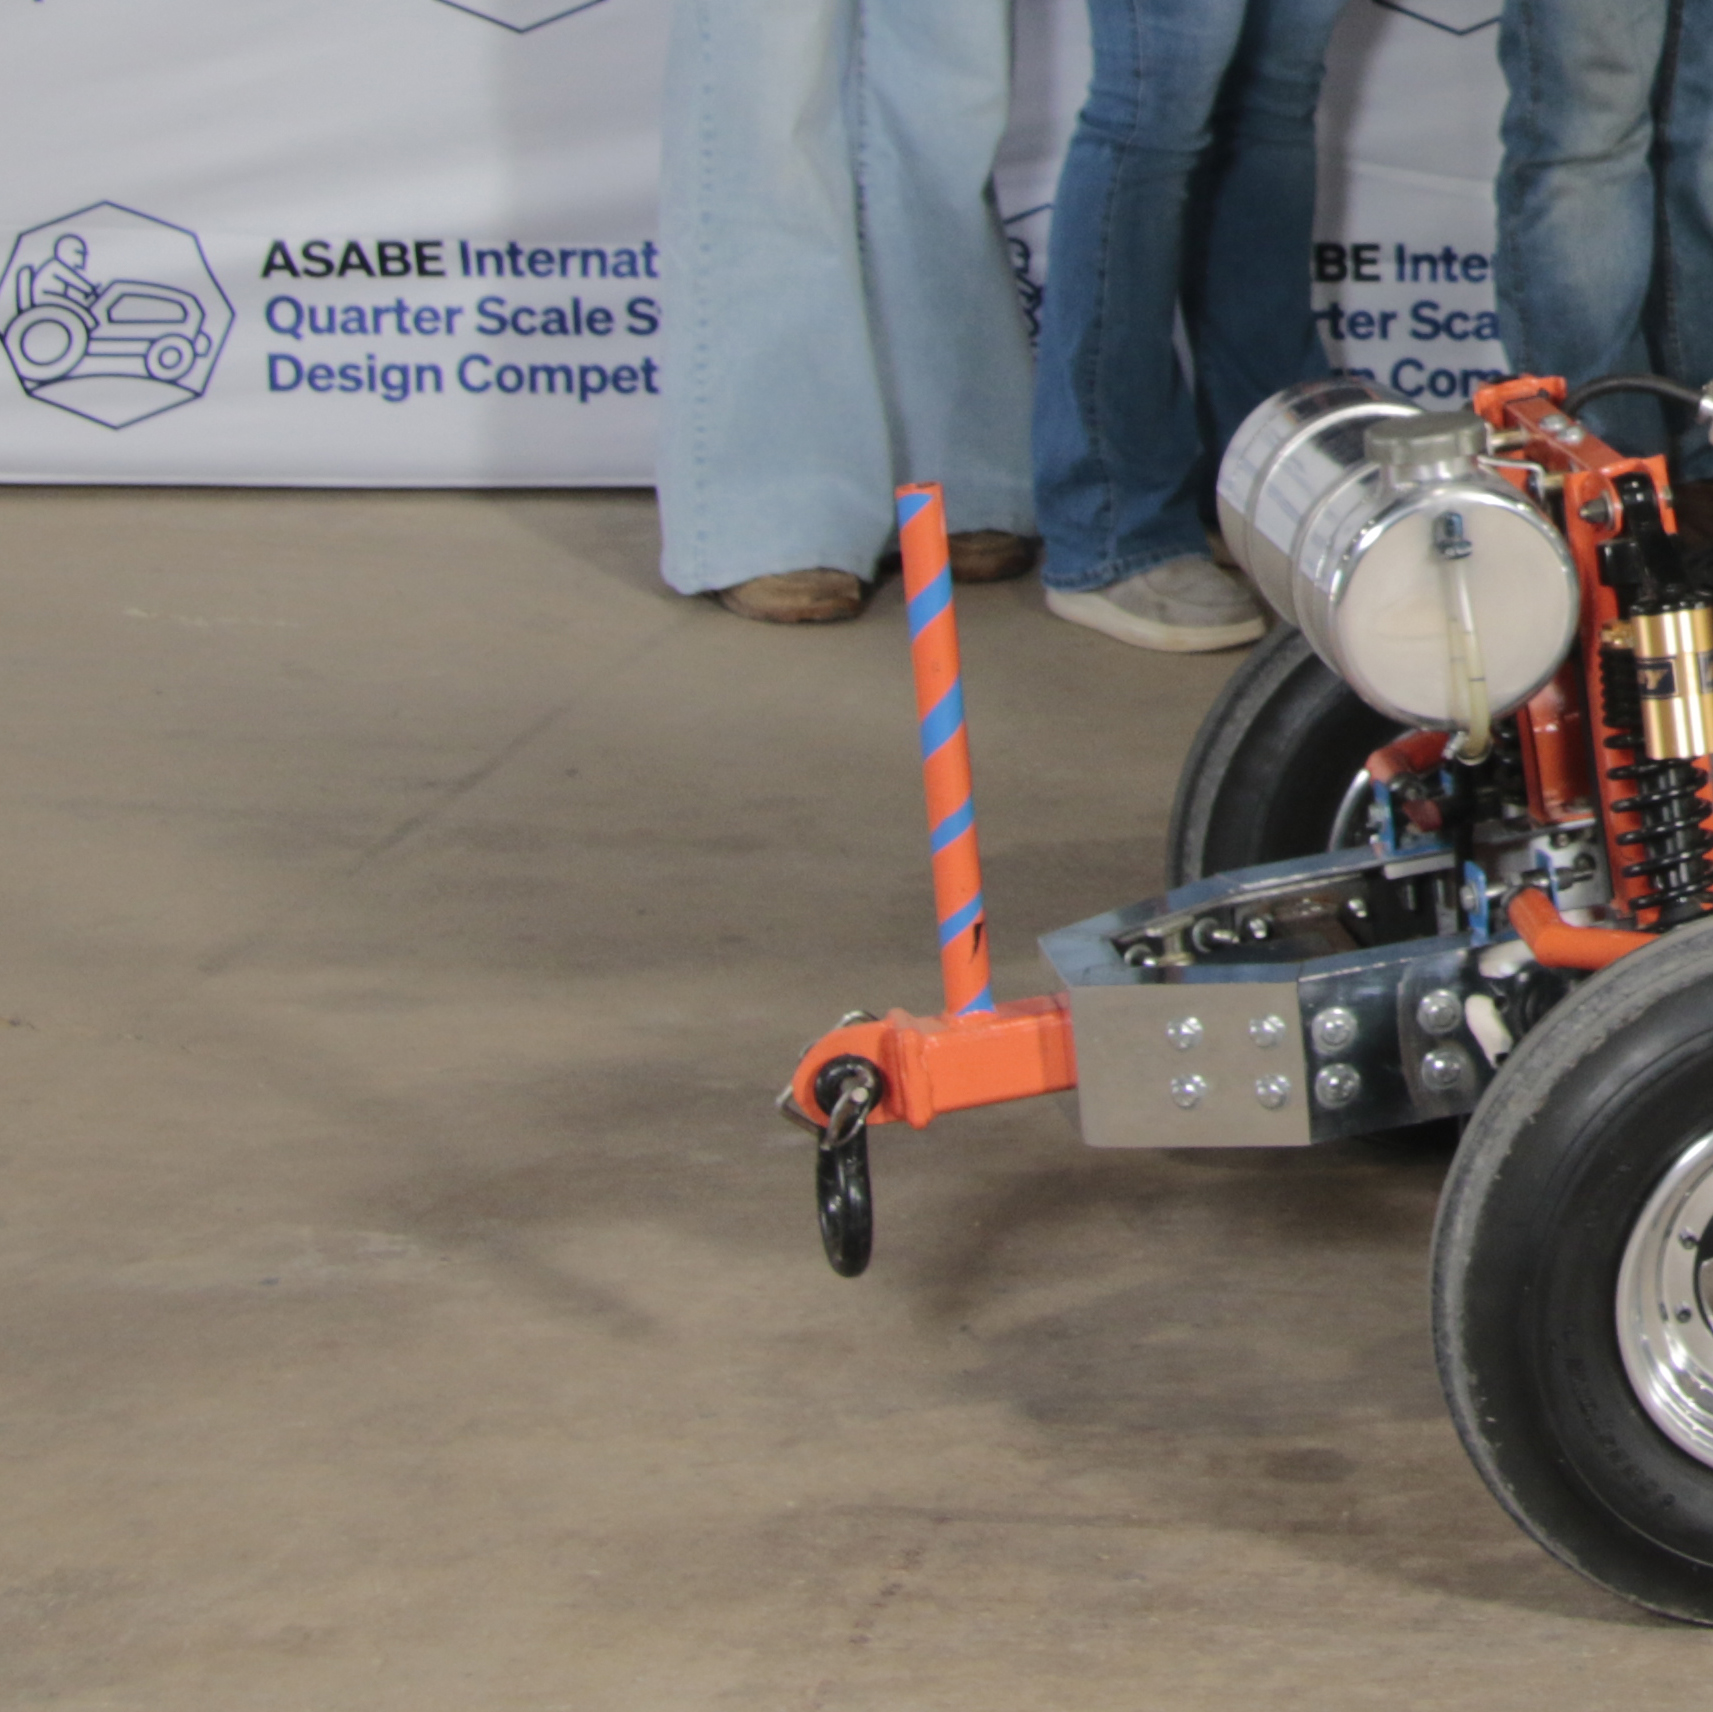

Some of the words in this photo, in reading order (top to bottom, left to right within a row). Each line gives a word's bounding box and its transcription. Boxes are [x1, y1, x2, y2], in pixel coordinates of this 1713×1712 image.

[261, 240, 445, 278] ASABE
[458, 238, 661, 279] Internat
[264, 295, 462, 340] Quarter
[476, 296, 614, 336] Scale
[267, 353, 442, 403] Design
[457, 355, 661, 402] Compet
